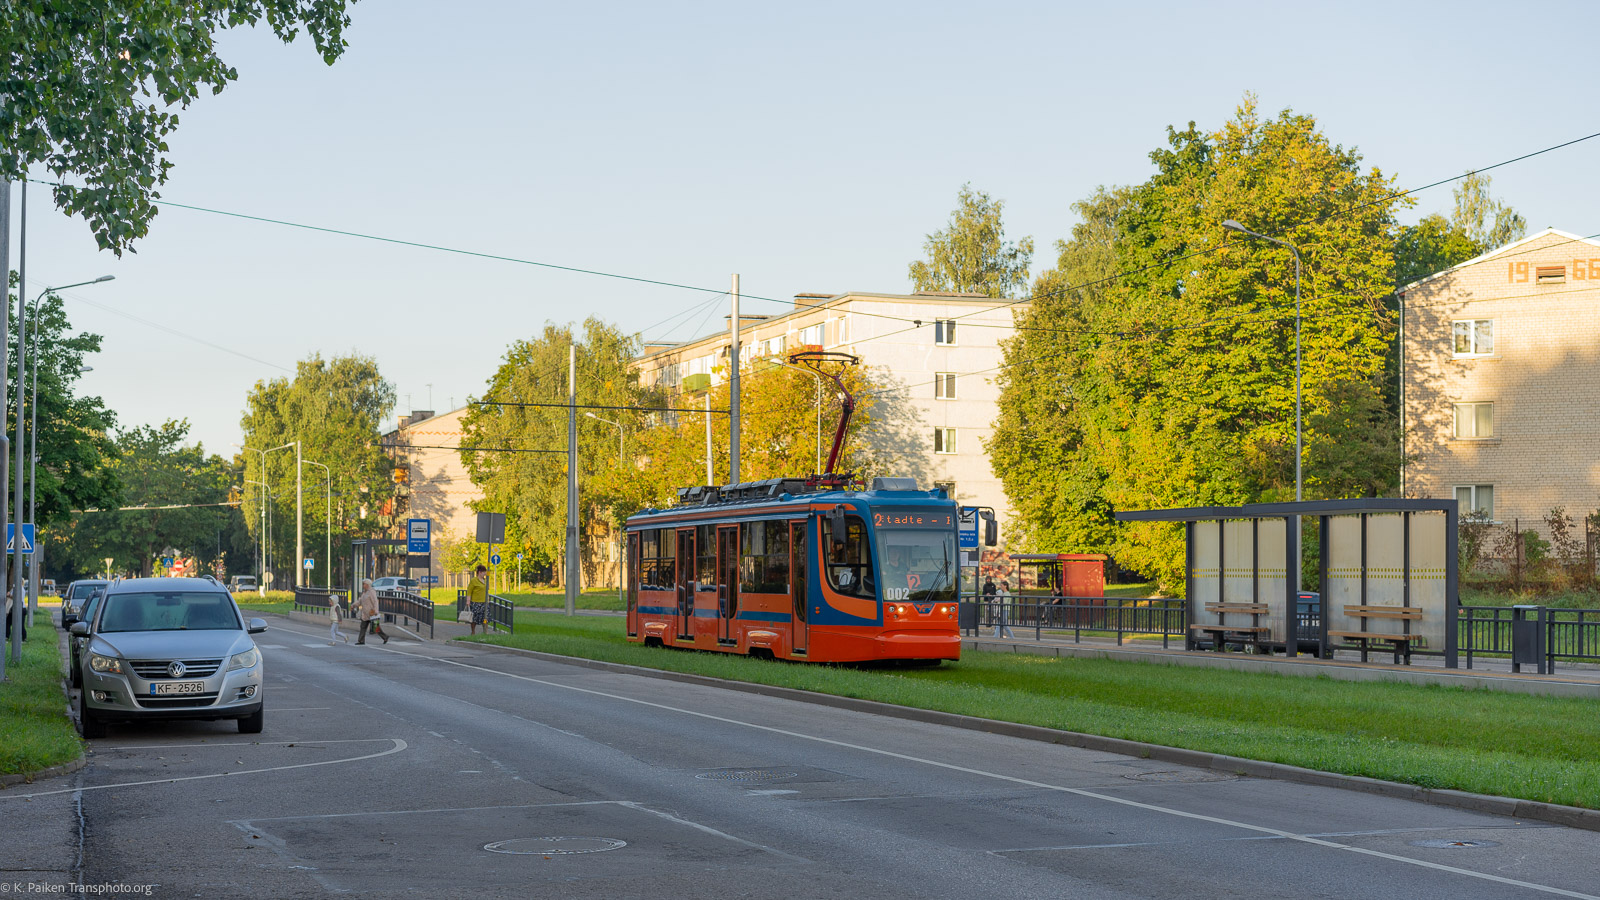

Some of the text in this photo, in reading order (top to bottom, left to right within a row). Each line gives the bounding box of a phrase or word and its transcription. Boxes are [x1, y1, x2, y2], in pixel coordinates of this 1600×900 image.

[1508, 258, 1600, 284] 19 66
[874, 513, 882, 527] 2
[909, 575, 919, 591] 2
[886, 587, 910, 600] 002
[157, 683, 202, 693] KF-2526
